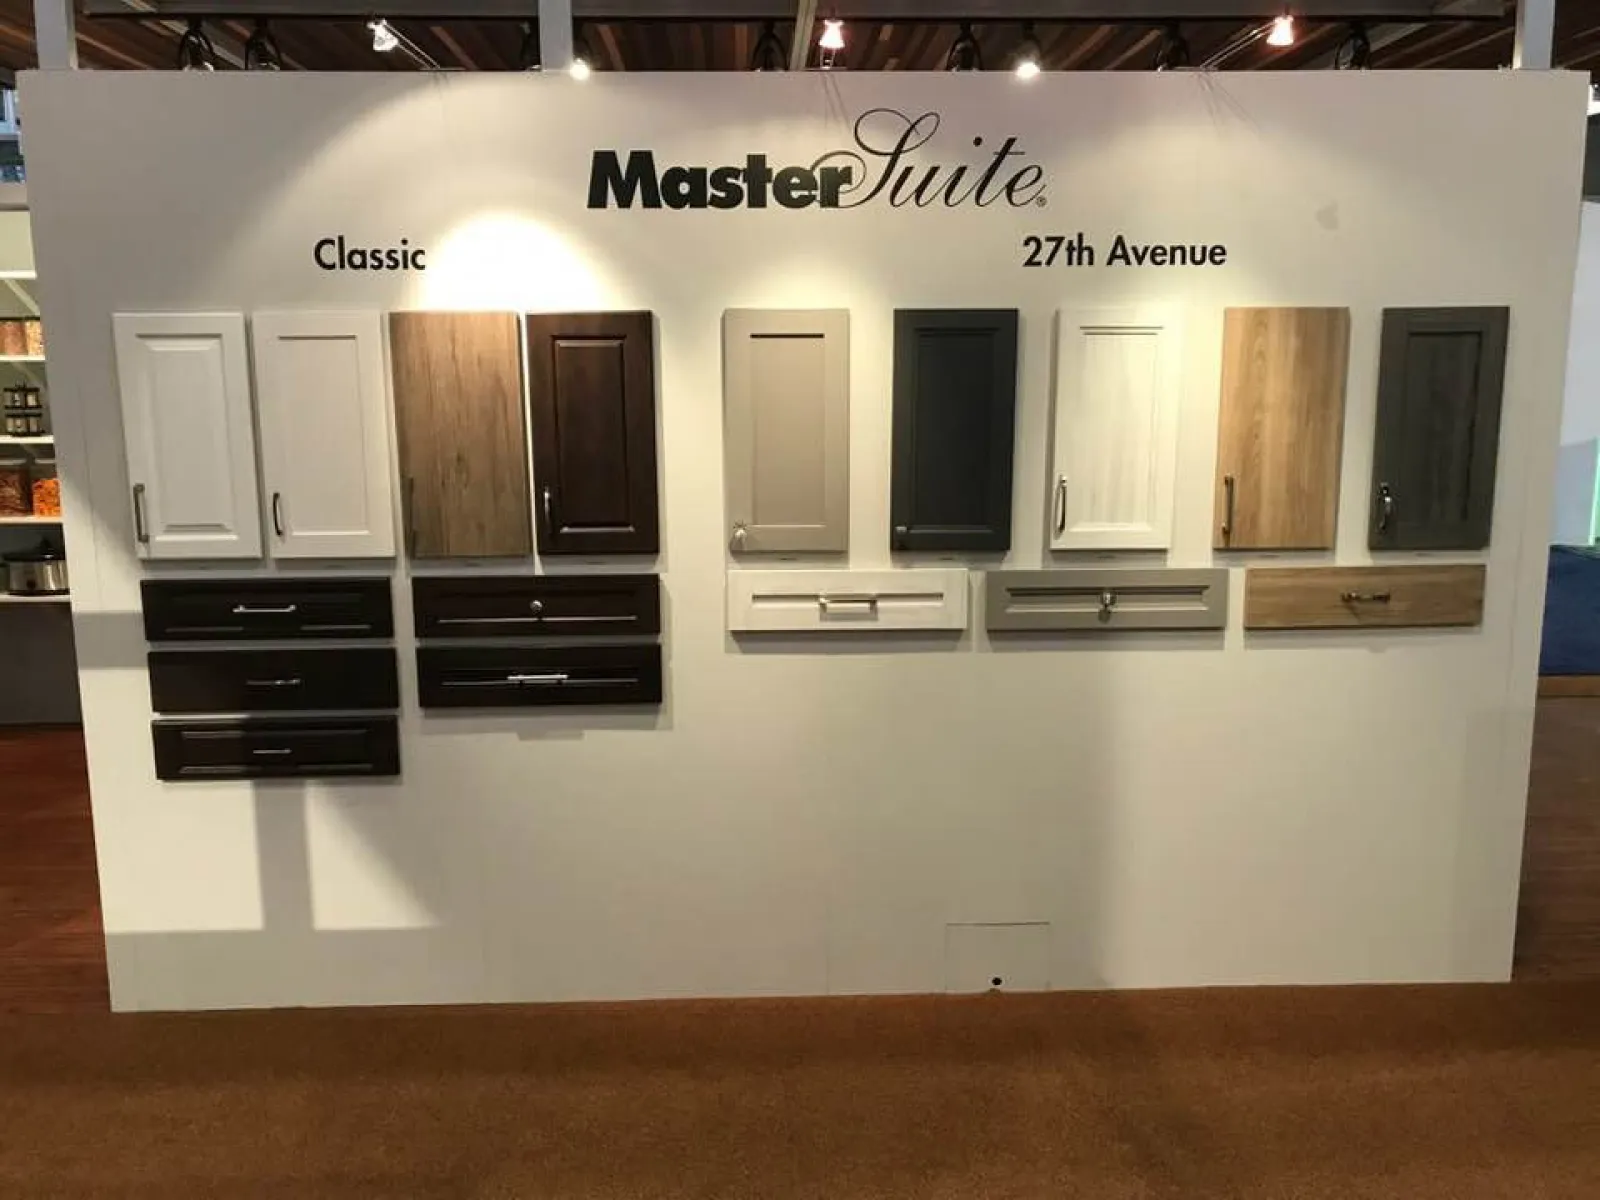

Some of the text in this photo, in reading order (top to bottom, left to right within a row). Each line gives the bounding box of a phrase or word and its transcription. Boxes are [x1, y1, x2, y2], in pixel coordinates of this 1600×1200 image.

[314, 235, 426, 271] Classic
[1023, 233, 1227, 267] 27th Avenue
